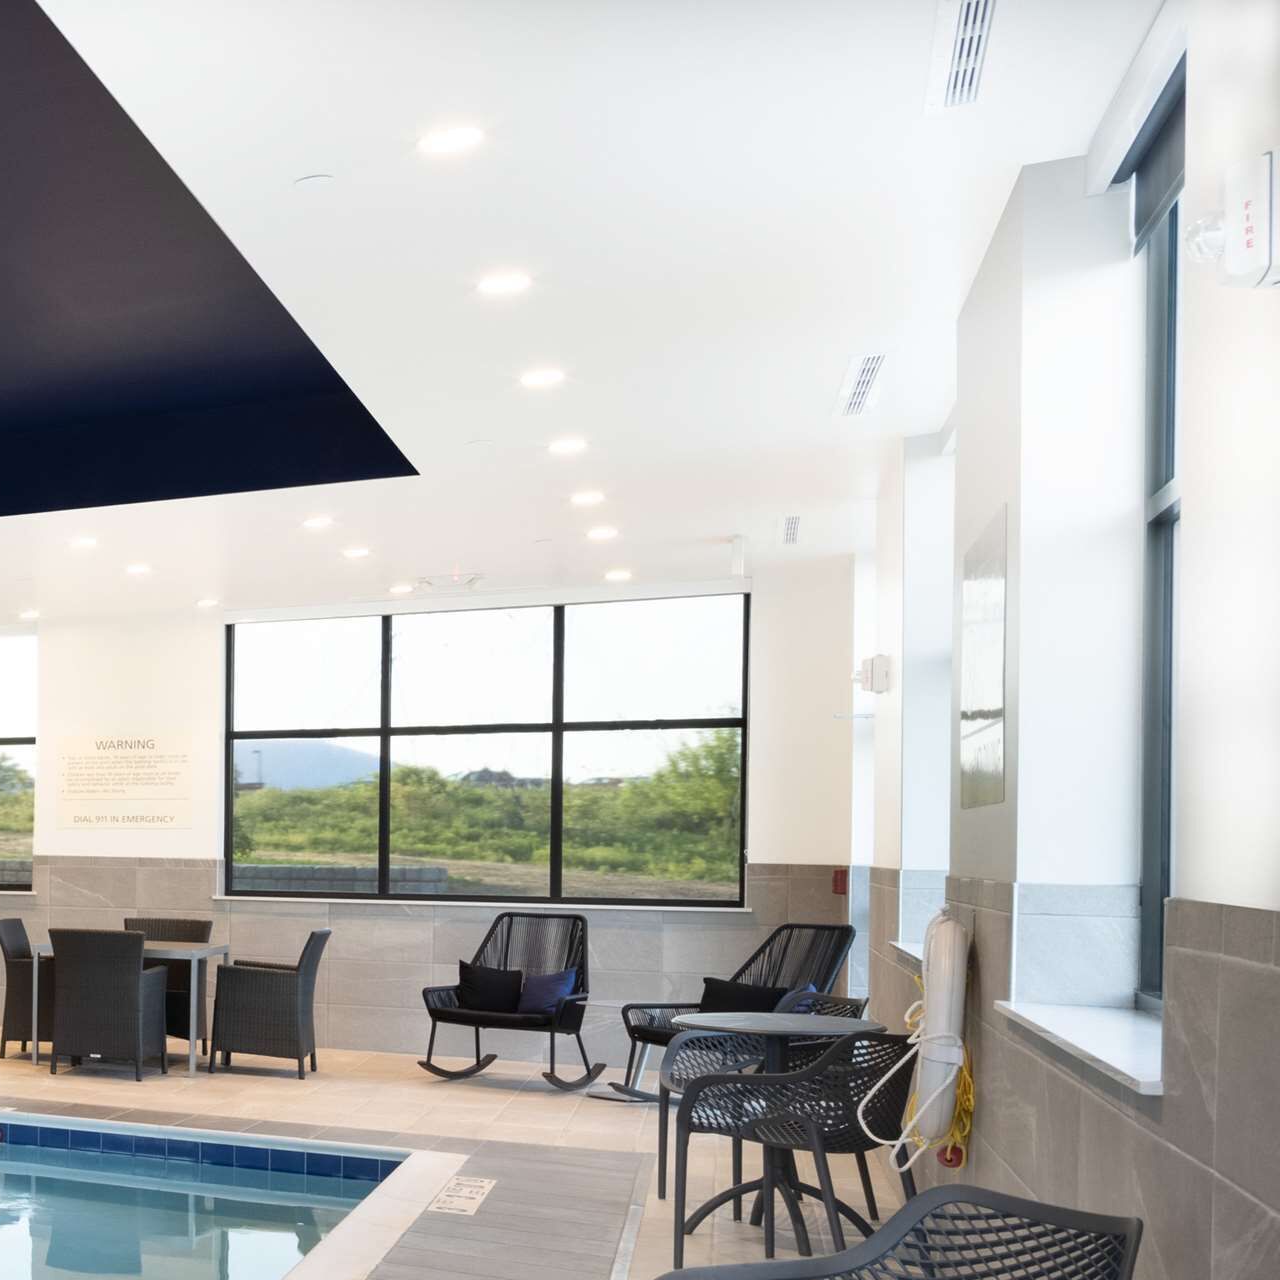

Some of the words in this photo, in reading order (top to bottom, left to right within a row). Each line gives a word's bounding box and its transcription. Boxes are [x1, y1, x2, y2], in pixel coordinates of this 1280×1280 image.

[1243, 199, 1255, 249] FIRE
[95, 739, 155, 750] WARNING
[73, 815, 93, 824] DIAL
[95, 815, 108, 824] 911
[110, 815, 119, 824] IN
[121, 815, 176, 824] EMERGENCY
